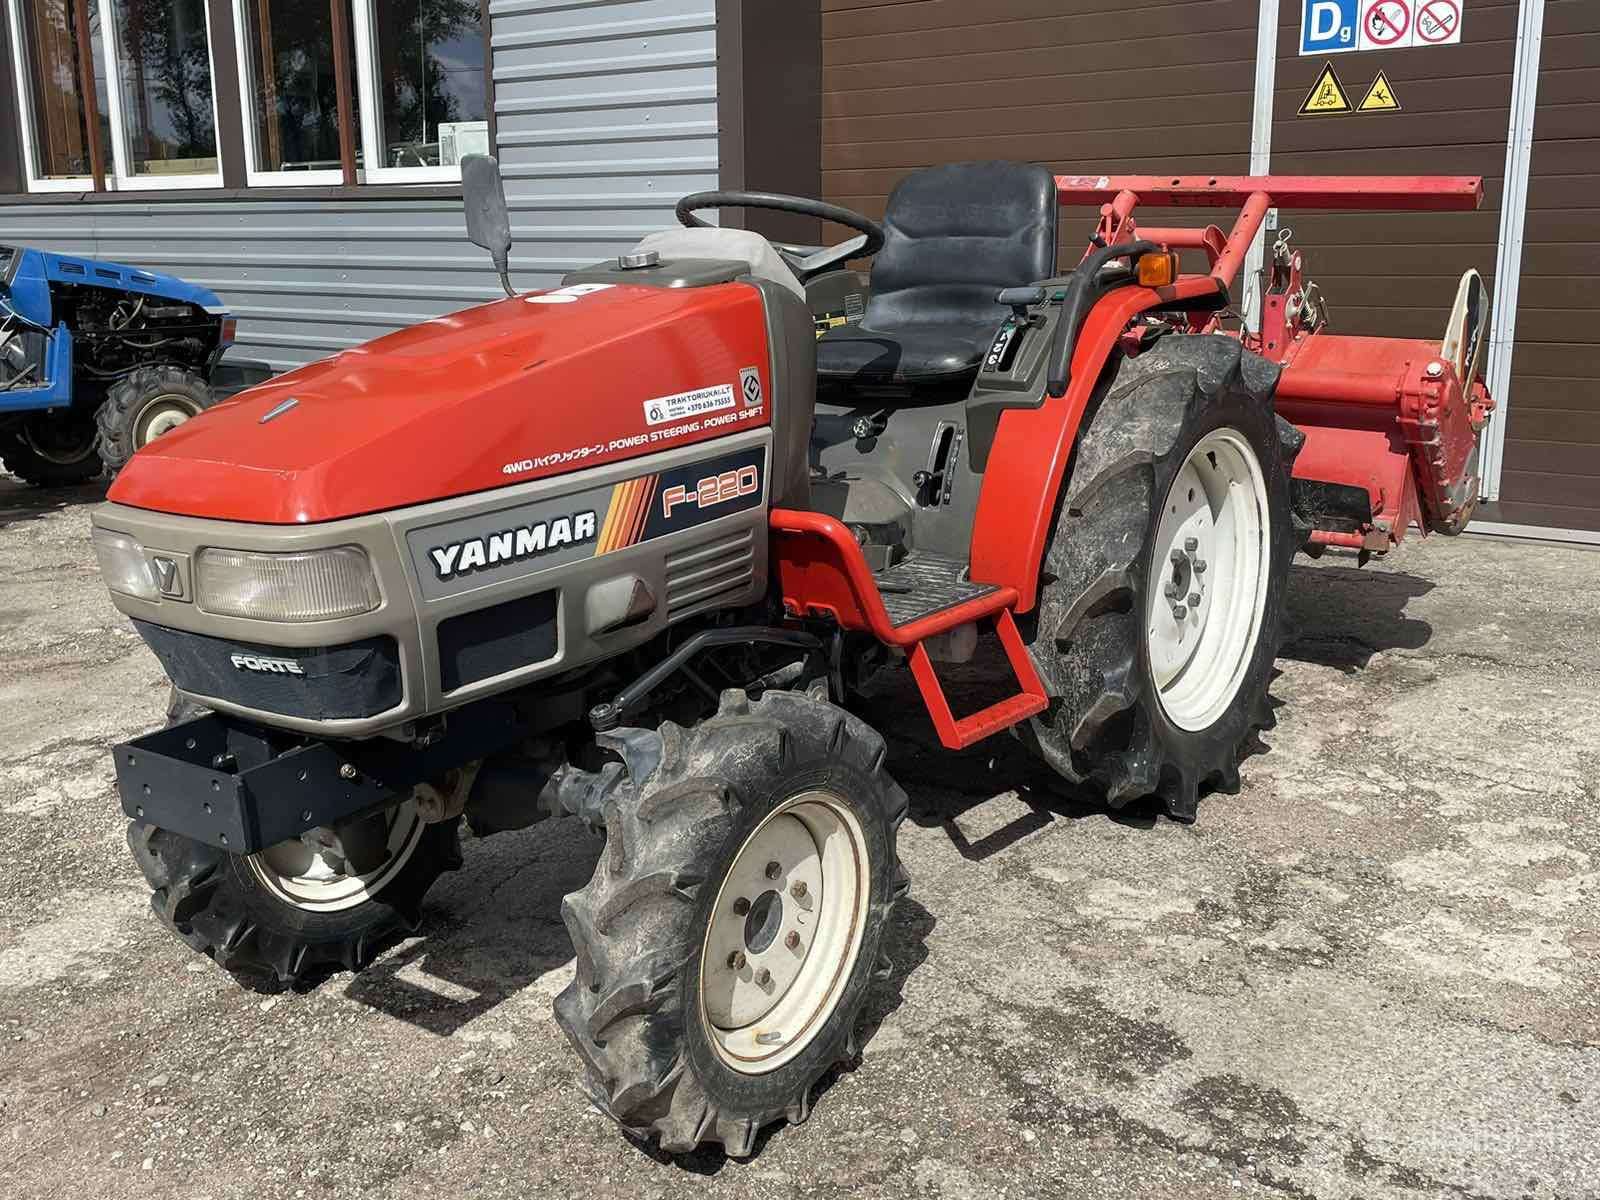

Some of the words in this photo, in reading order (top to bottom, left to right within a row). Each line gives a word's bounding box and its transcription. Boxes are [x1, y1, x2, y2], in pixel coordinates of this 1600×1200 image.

[609, 433, 648, 451] POWER
[704, 413, 737, 428] POWER
[738, 406, 763, 420] SHIFT
[662, 465, 758, 518] F-220
[430, 511, 597, 578] YANMAR
[230, 654, 304, 674] FORTE
